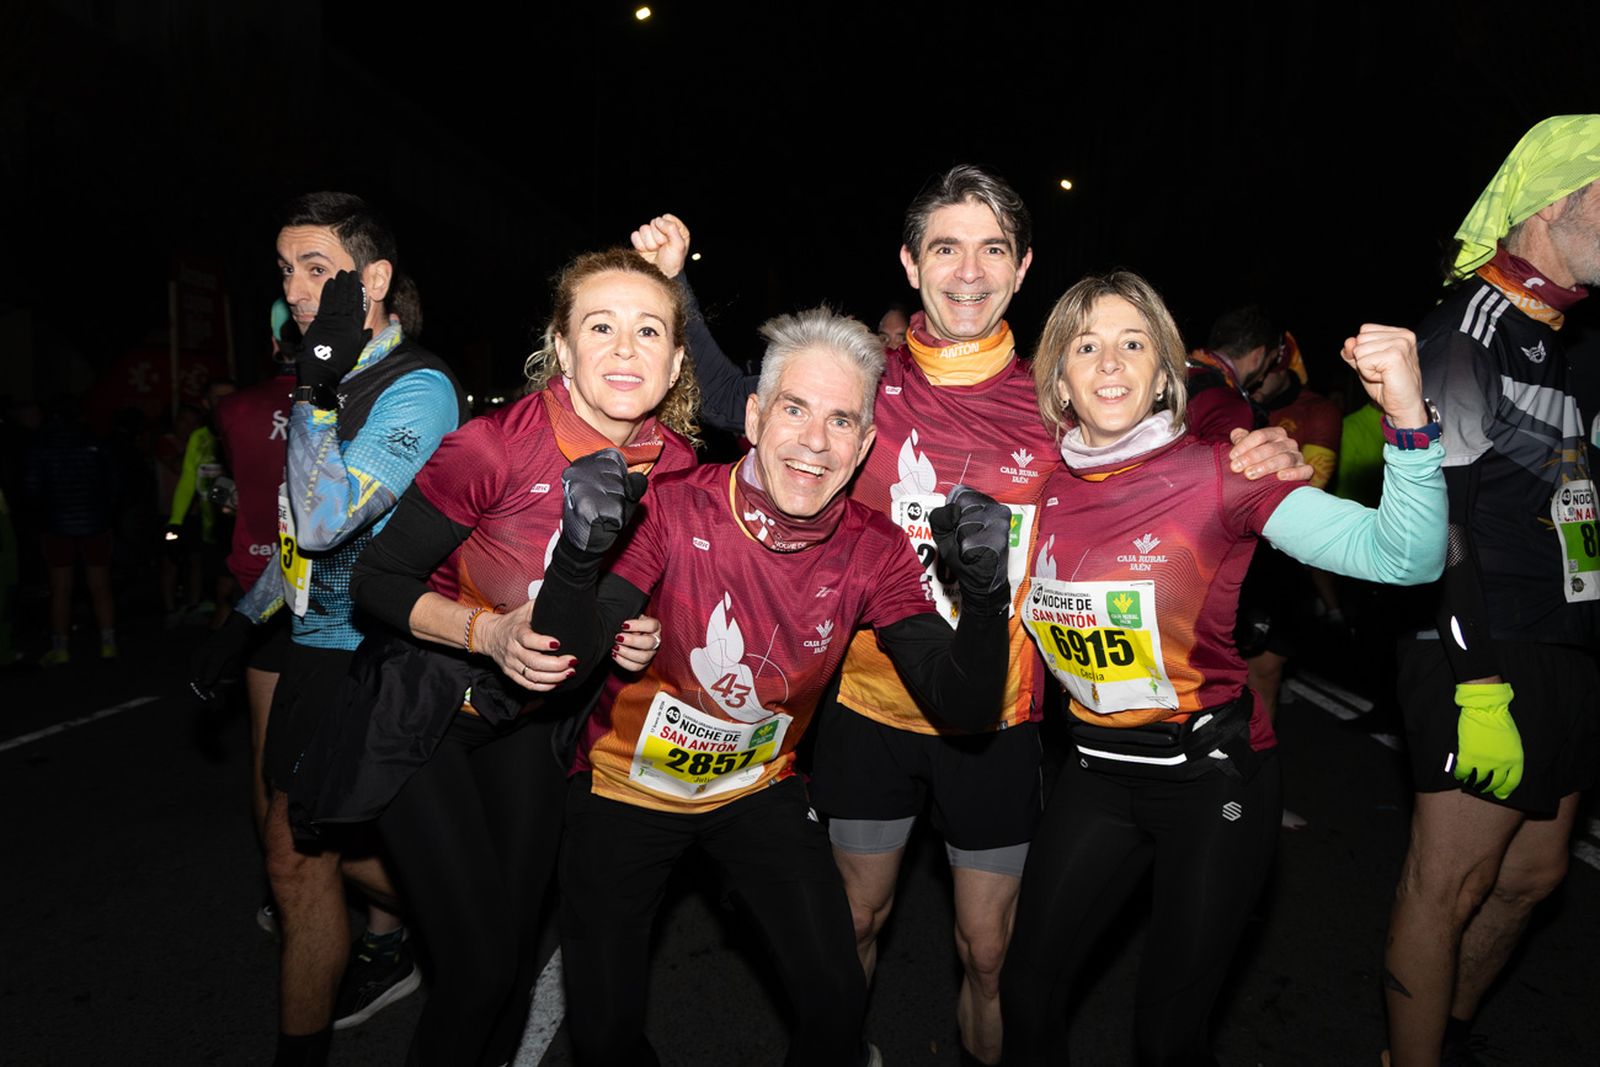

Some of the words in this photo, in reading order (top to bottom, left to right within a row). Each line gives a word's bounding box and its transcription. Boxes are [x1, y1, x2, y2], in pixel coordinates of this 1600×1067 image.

[907, 524, 933, 541] SAN
[1042, 594, 1074, 610] NOCHE
[1076, 599, 1093, 611] DE
[1032, 608, 1055, 622] SAN
[1055, 611, 1097, 628] ANTÓN
[1049, 625, 1135, 668] 6915
[711, 673, 752, 708] 43
[658, 725, 689, 747] SAN
[688, 739, 738, 753] ANTÓN
[679, 718, 722, 742] NOCHE
[722, 732, 742, 742] DE
[665, 747, 757, 776] 2857
